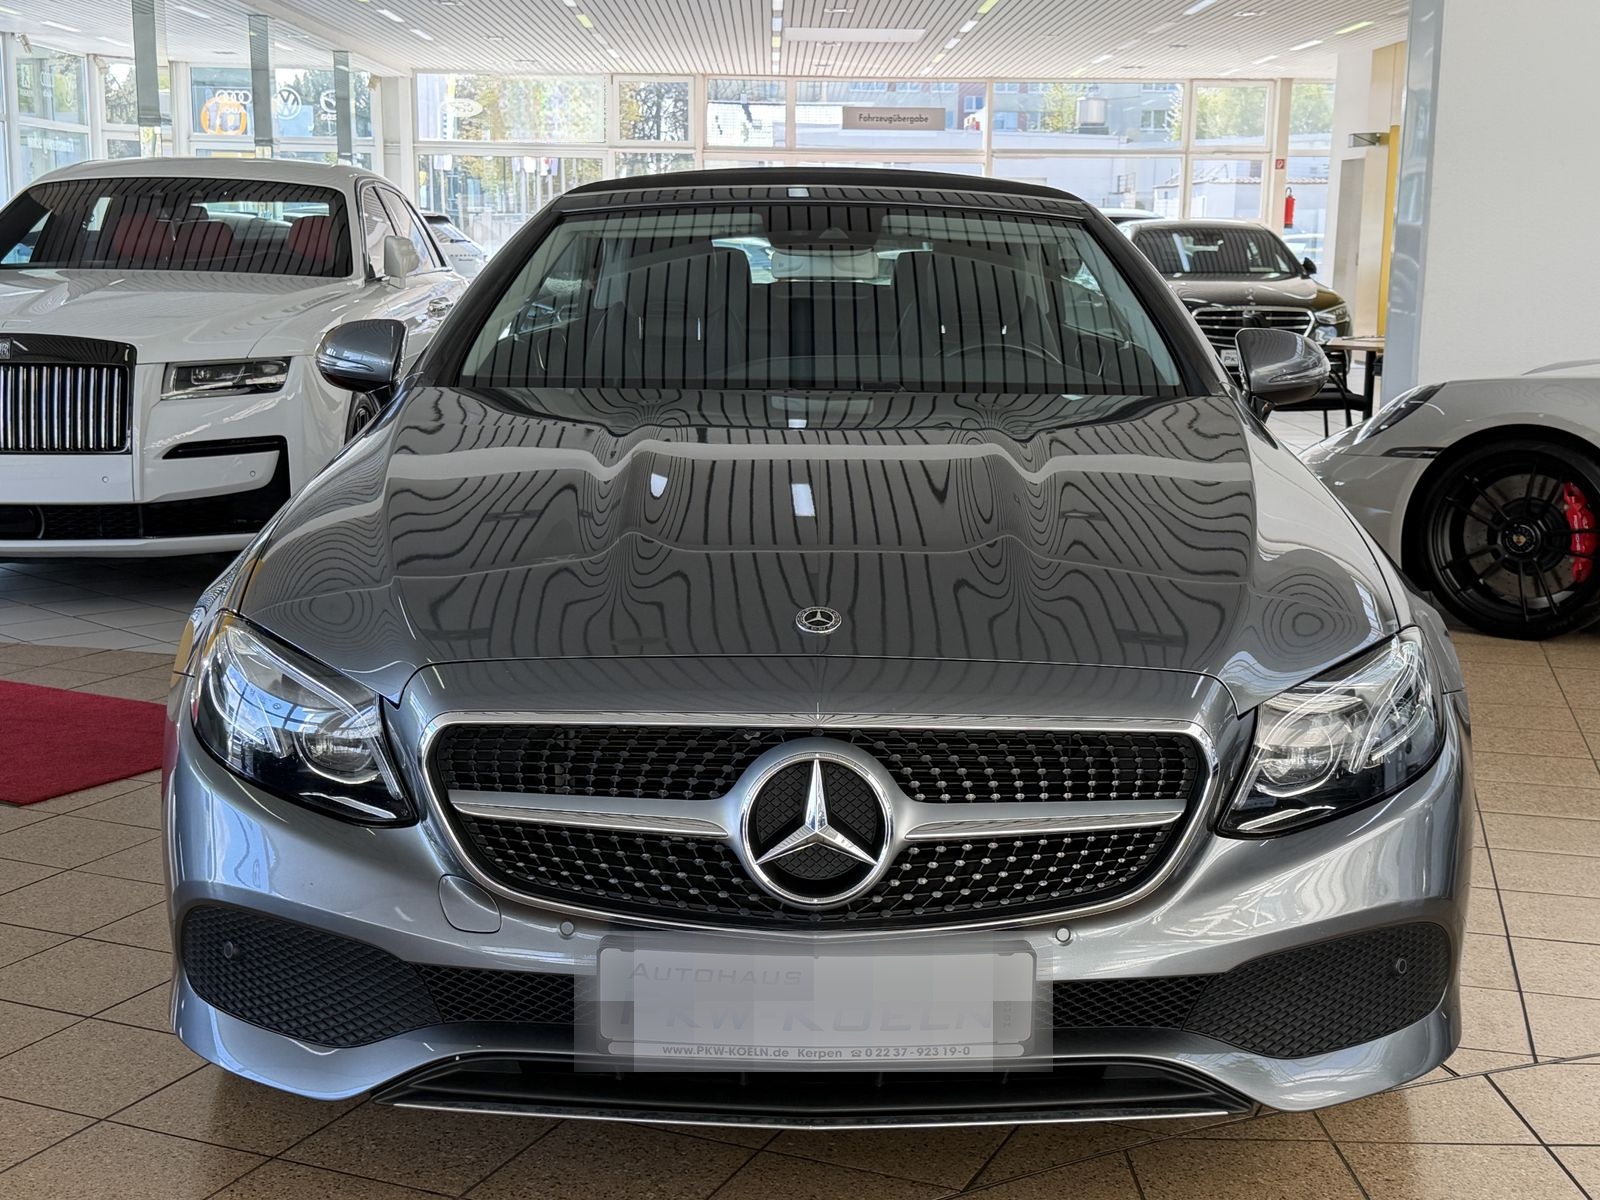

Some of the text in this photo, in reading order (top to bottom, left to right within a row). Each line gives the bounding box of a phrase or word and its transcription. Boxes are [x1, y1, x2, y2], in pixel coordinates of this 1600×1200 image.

[858, 113, 929, 125] Fahrzeugübergabe
[628, 962, 803, 985] AUTOHAUS
[662, 1045, 789, 1059] www.PKW-KOELN.de
[797, 1048, 842, 1061] Kerpen
